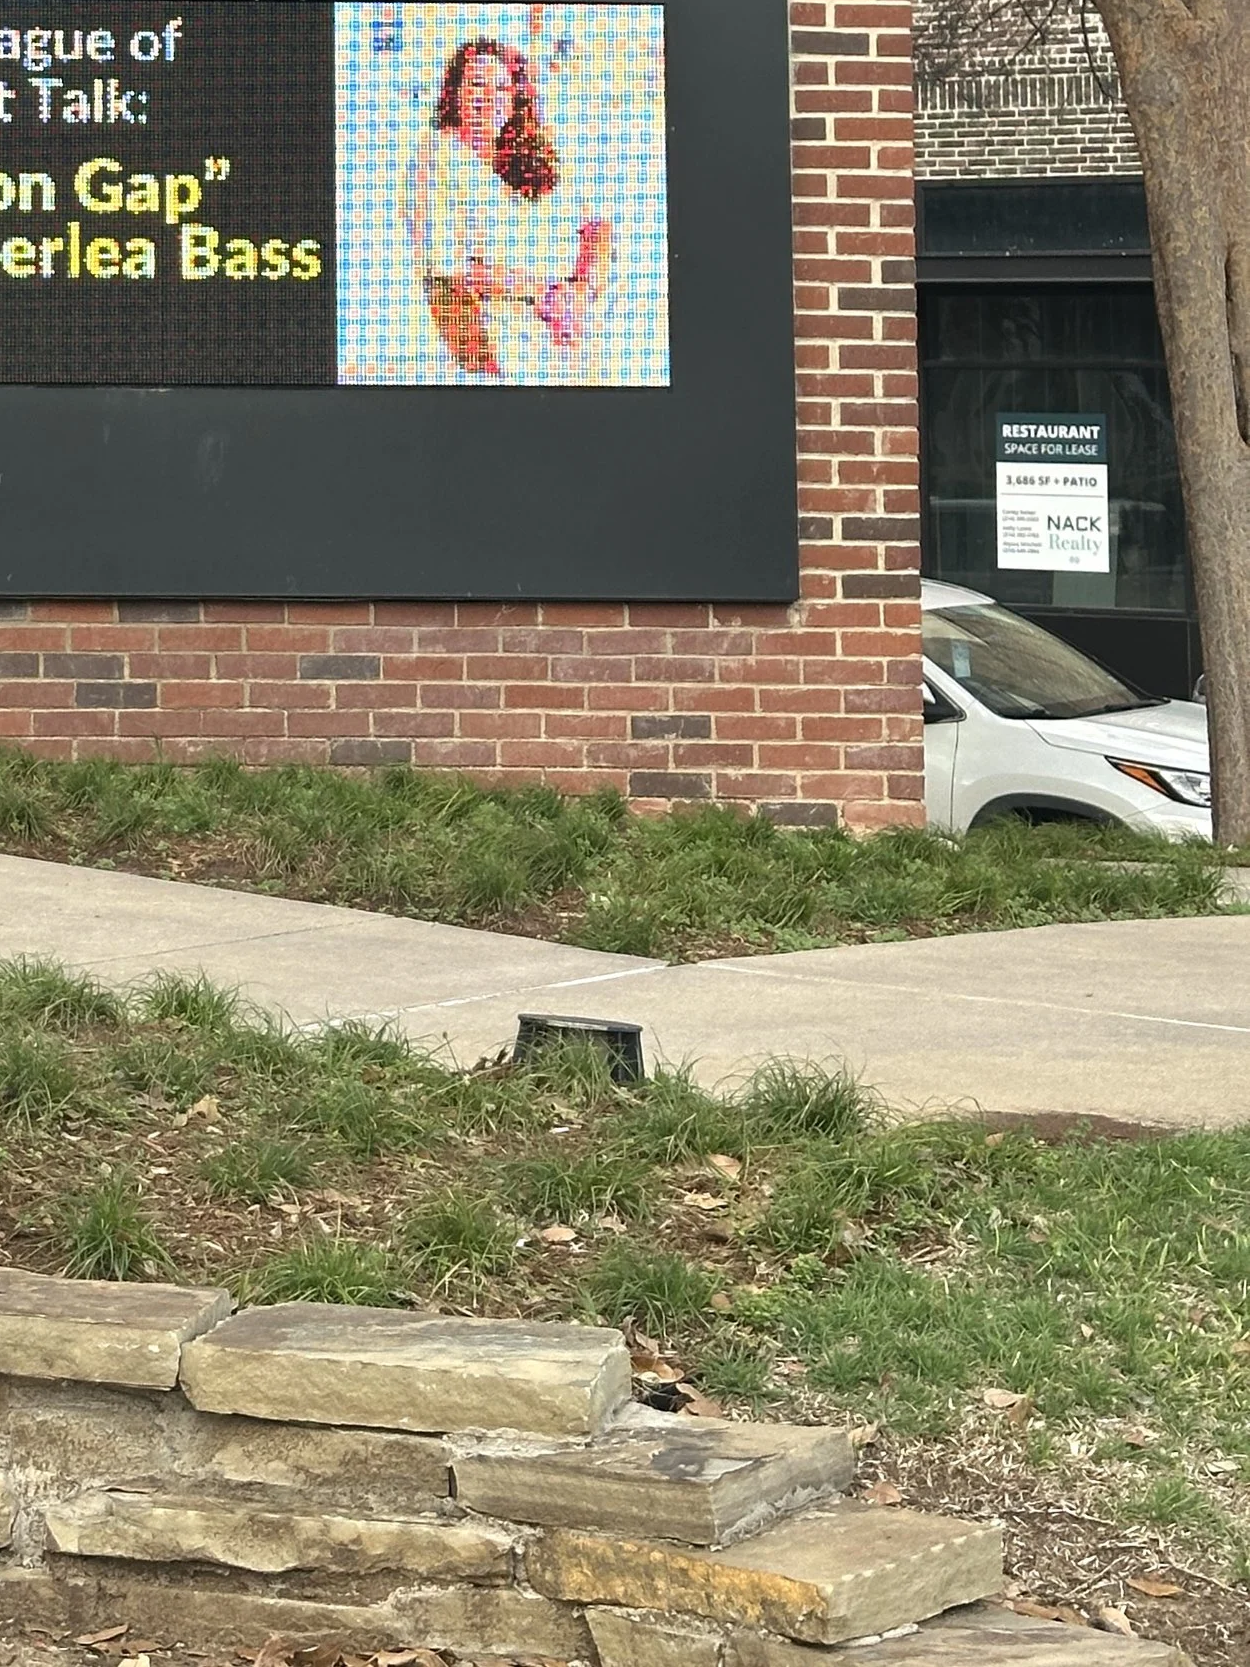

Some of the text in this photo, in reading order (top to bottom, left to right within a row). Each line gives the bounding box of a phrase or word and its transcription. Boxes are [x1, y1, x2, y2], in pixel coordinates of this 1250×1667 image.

[129, 16, 183, 63] of
[37, 77, 148, 125] Talk:
[181, 224, 322, 282] Bass
[1002, 424, 1100, 439] RESTAURANT
[1004, 442, 1098, 456] SPACE FOR LEASE
[1038, 476, 1051, 486] SF
[1063, 477, 1097, 487] PATIO
[1047, 515, 1102, 532] NACK
[1049, 533, 1102, 556] Realty
